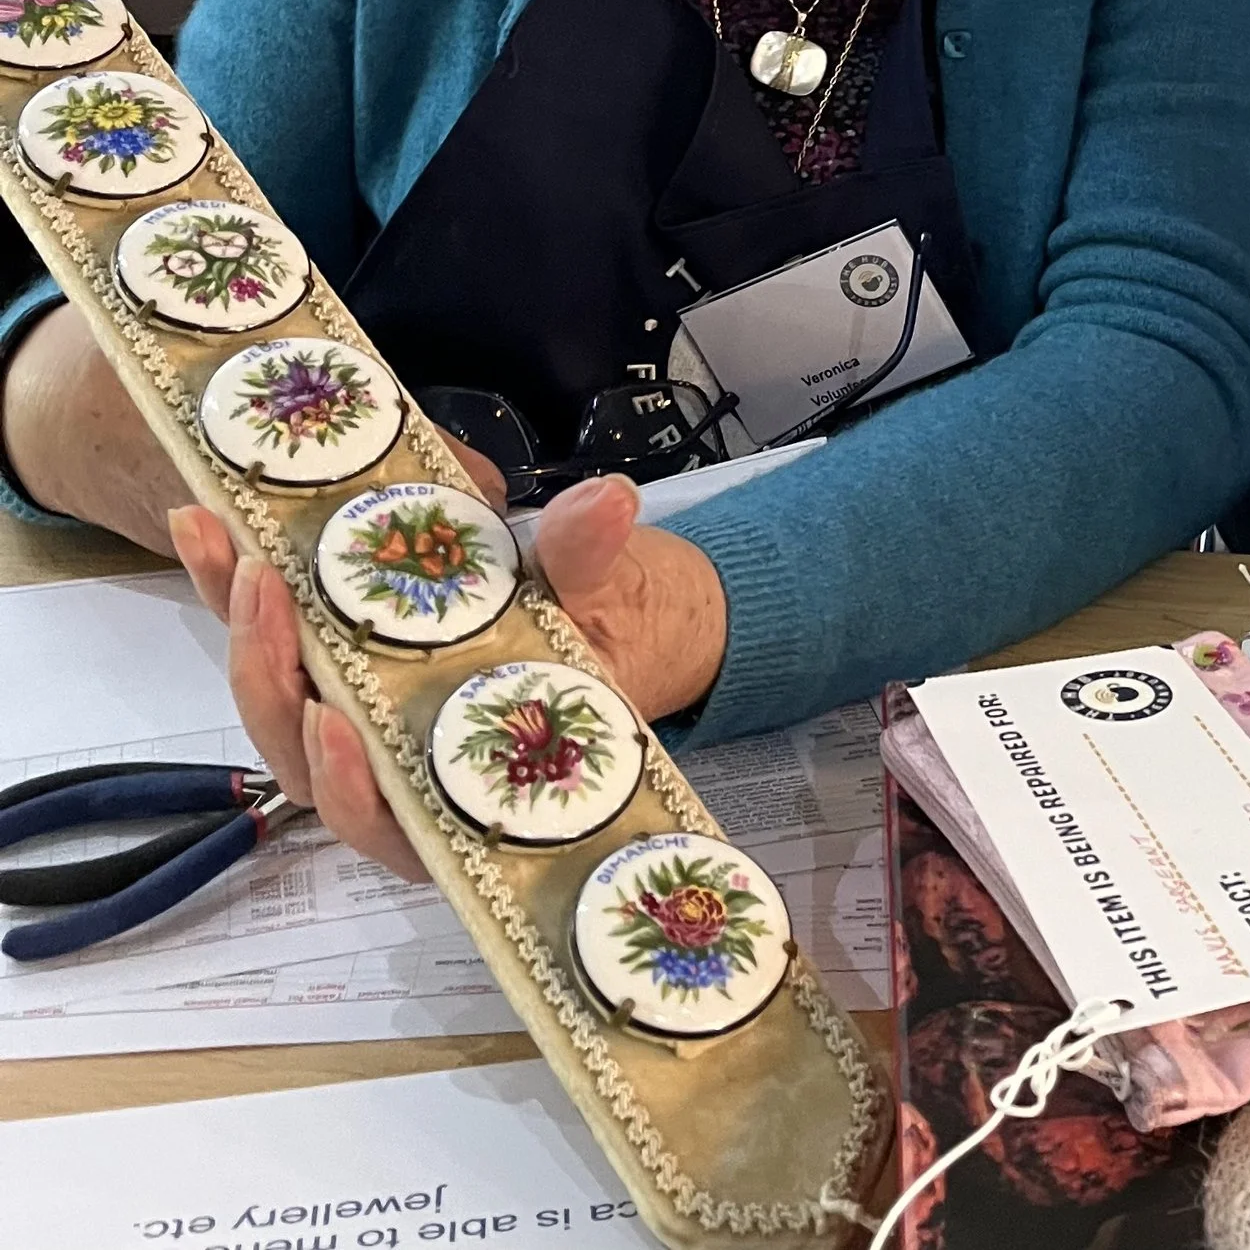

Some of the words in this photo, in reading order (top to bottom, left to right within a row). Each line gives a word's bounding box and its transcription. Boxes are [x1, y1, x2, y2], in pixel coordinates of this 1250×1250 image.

[800, 357, 861, 387] Veronica
[343, 485, 435, 520] VENDREDI
[978, 693, 1014, 727] FOR:
[999, 730, 1066, 810] REPAIRED
[1048, 811, 1101, 867] BEING
[597, 836, 690, 884] DIMANCHE
[1083, 870, 1115, 891] IS
[1096, 894, 1147, 945] ITEM
[1129, 947, 1179, 999] THIS
[232, 1185, 449, 1230] jewellery
[536, 1209, 571, 1232] is
[133, 1215, 216, 1240] etc.
[356, 1228, 398, 1247] to
[418, 1213, 517, 1243] able
